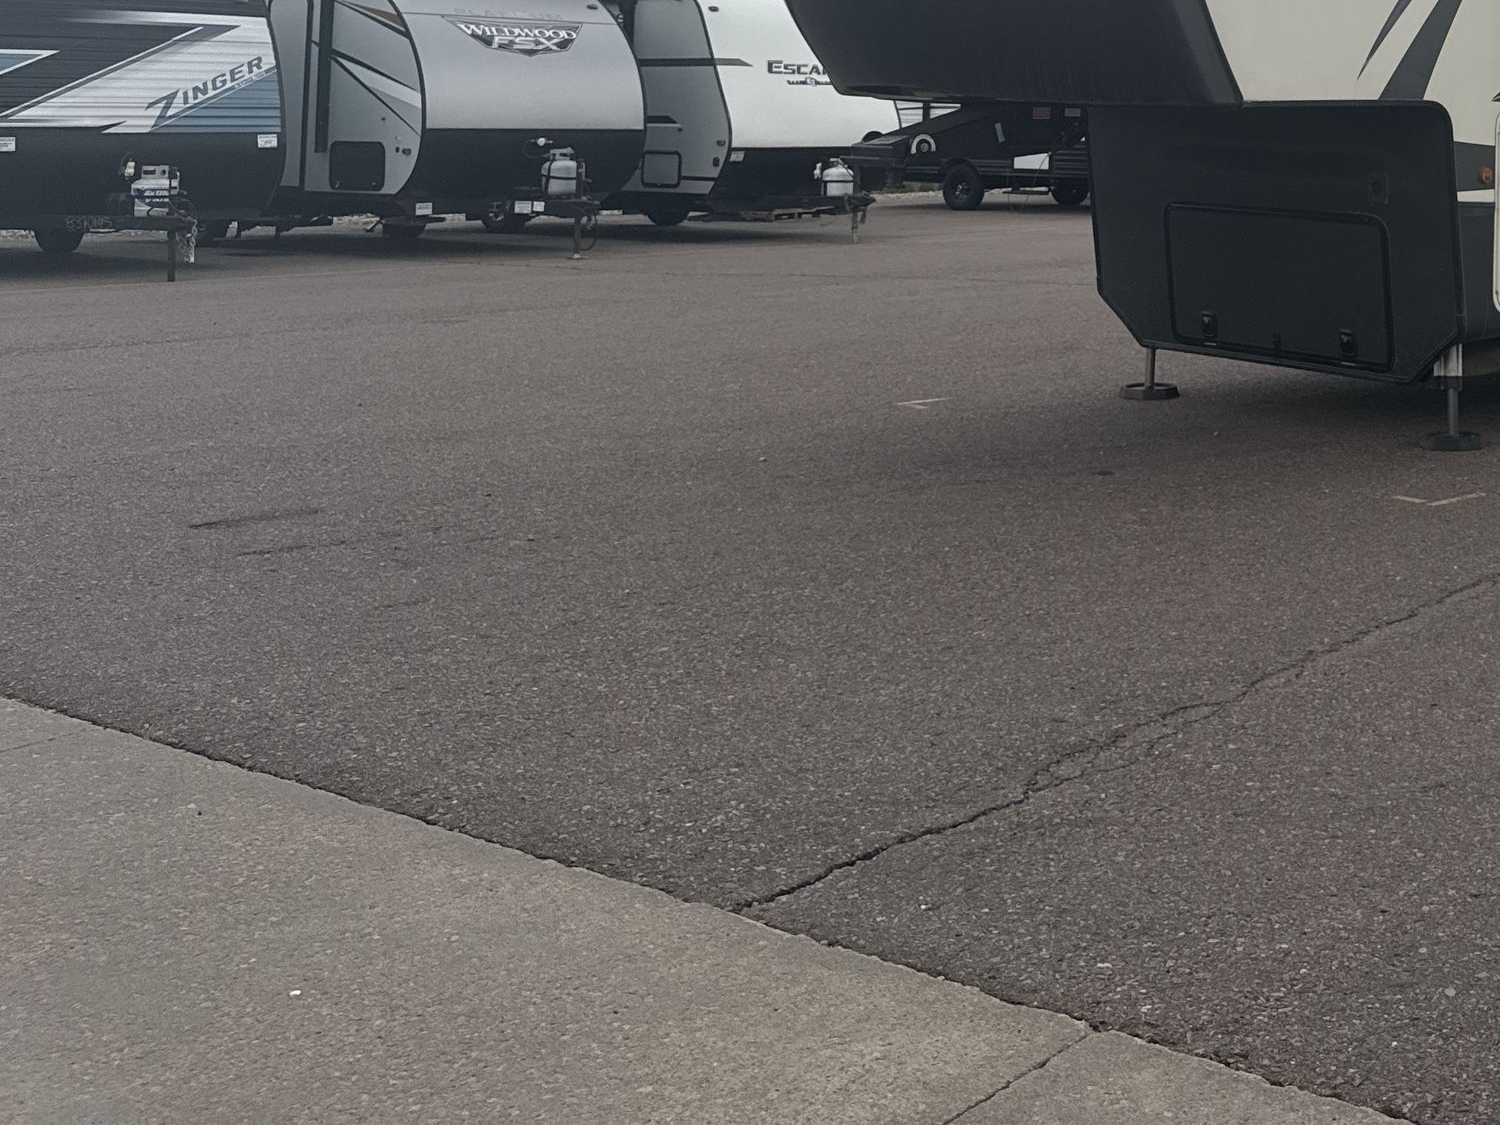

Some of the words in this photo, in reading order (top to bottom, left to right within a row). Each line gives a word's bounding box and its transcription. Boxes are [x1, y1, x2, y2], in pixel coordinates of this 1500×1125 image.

[458, 23, 577, 38] WILDWOOD
[491, 36, 564, 50] FSX
[144, 56, 263, 129] ZINGER
